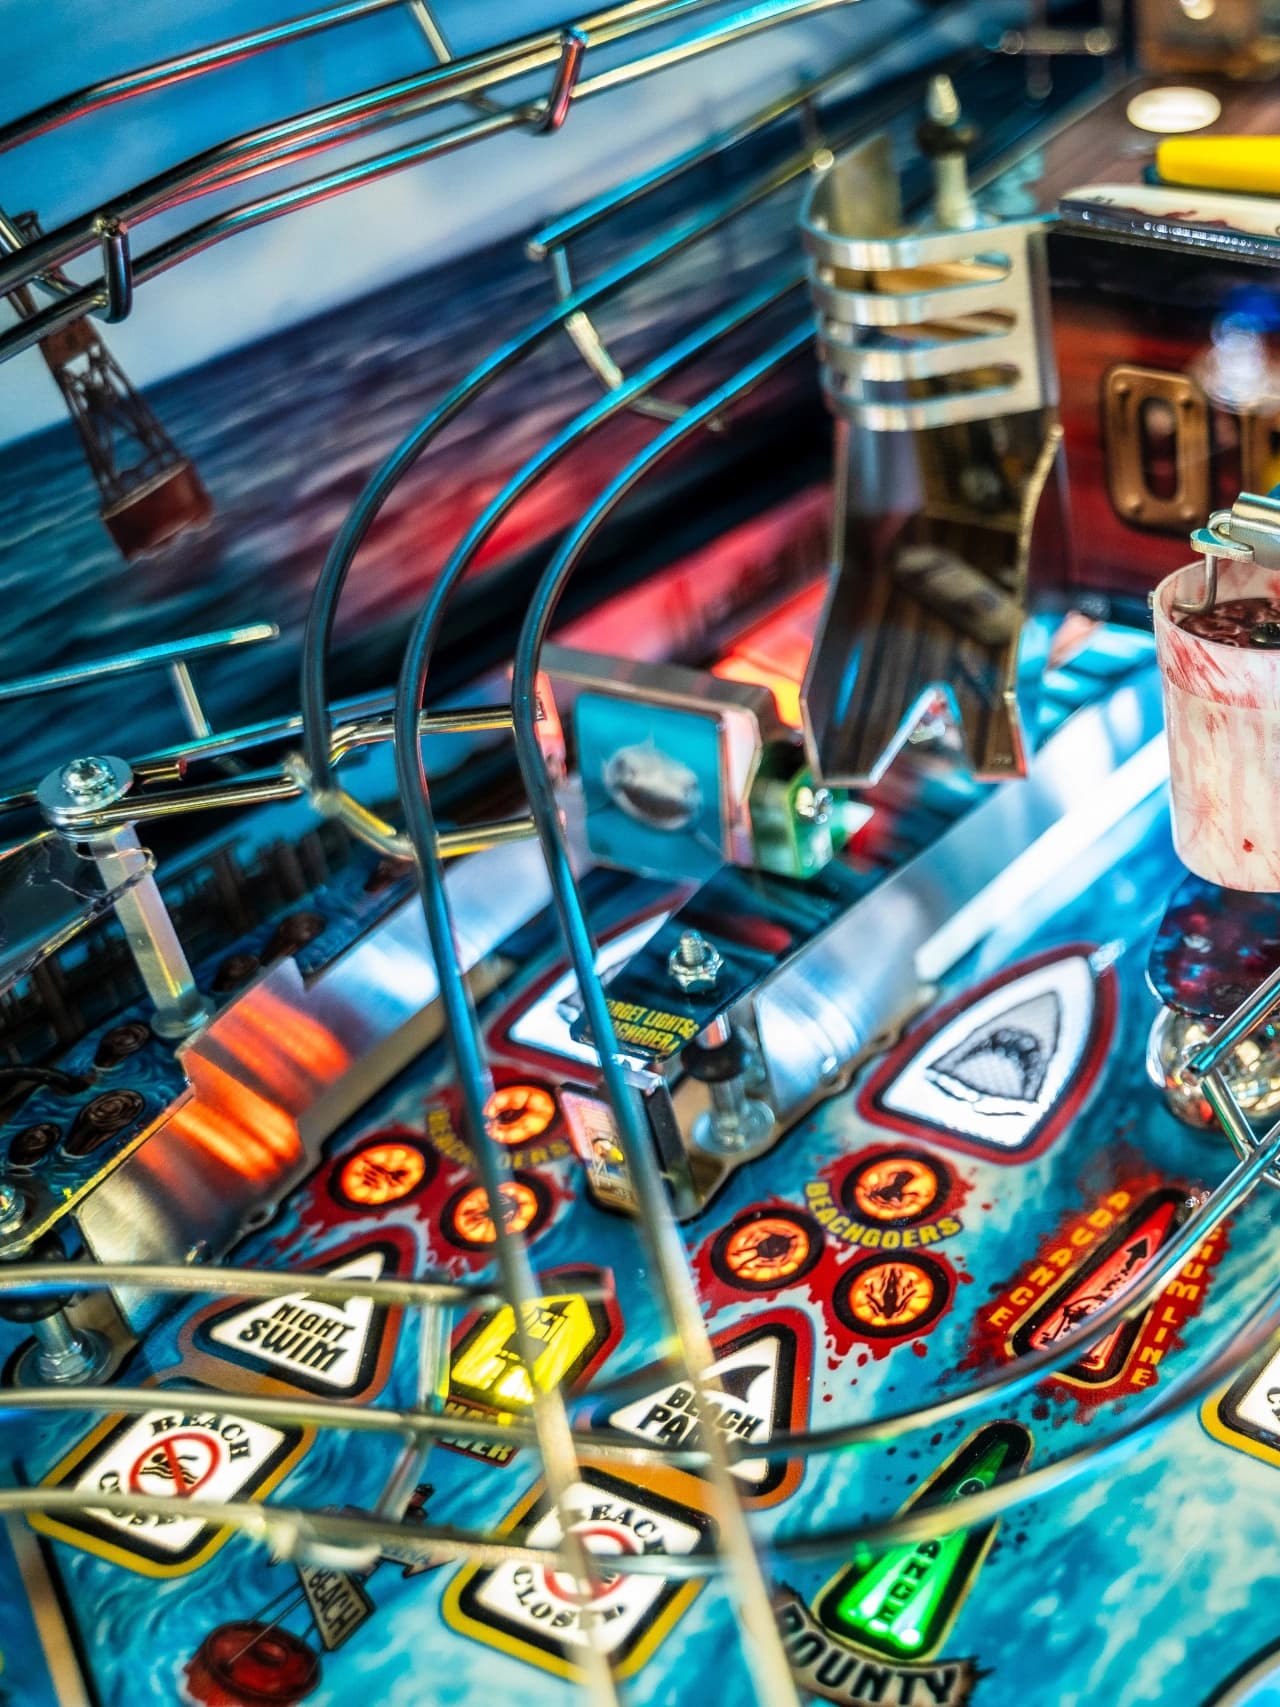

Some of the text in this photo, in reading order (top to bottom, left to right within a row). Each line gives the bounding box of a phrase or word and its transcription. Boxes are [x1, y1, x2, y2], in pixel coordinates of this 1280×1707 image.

[606, 1001, 648, 1022] ARGET
[805, 1181, 962, 1249] BEACHGOERS
[988, 1191, 1131, 1327] ADVANCE
[238, 1318, 350, 1373] SWIM
[271, 1302, 356, 1342] NIGHT
[1130, 1306, 1177, 1386] LINE
[511, 1565, 626, 1628] CLOSD
[781, 1600, 962, 1706] BOUNTY
